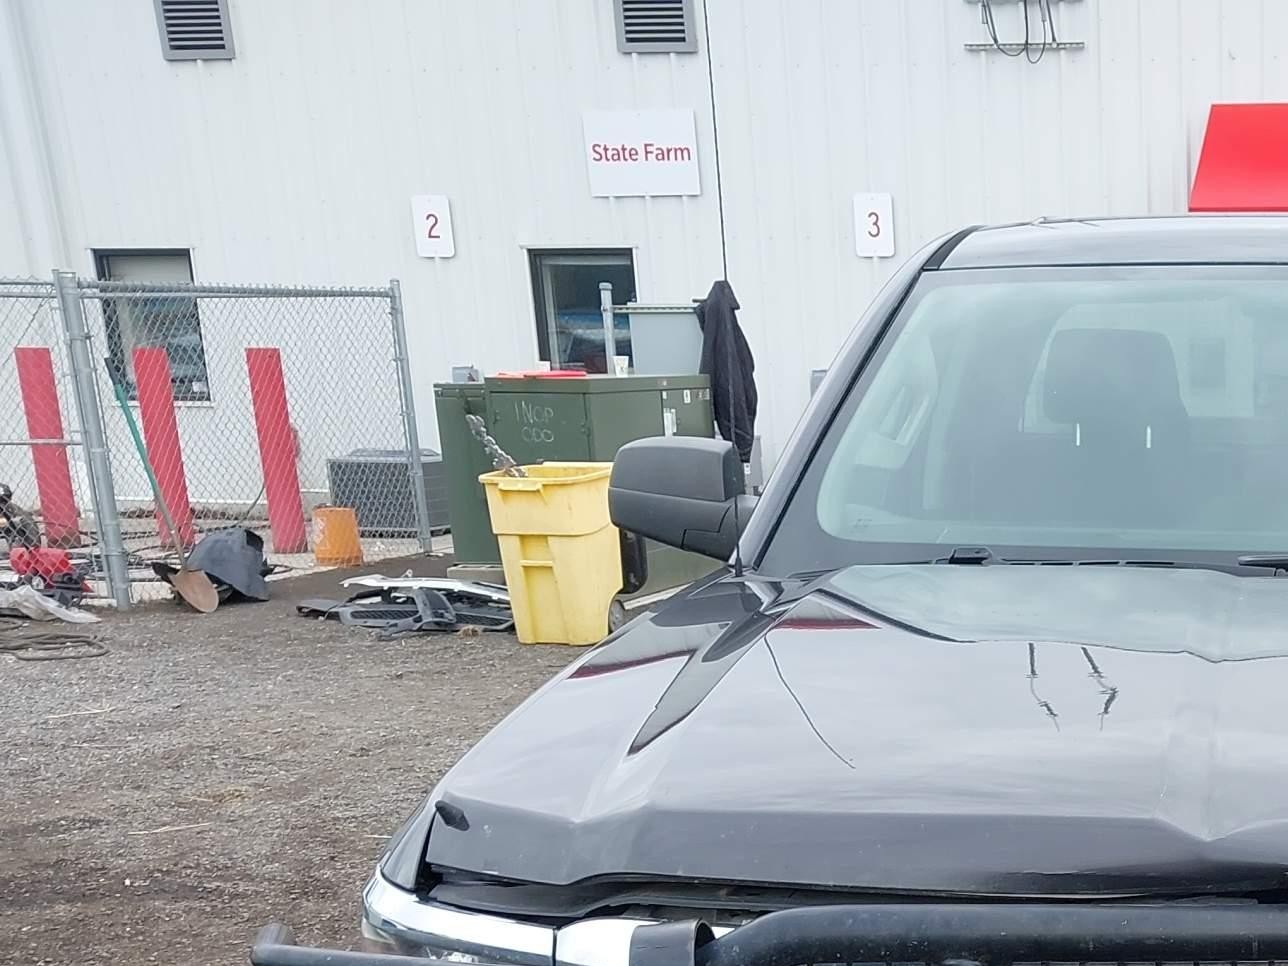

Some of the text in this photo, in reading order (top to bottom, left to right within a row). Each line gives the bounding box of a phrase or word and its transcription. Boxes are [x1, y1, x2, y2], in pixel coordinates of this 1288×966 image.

[591, 143, 691, 162] State Farm
[425, 213, 441, 239] 2
[867, 211, 881, 238] 3
